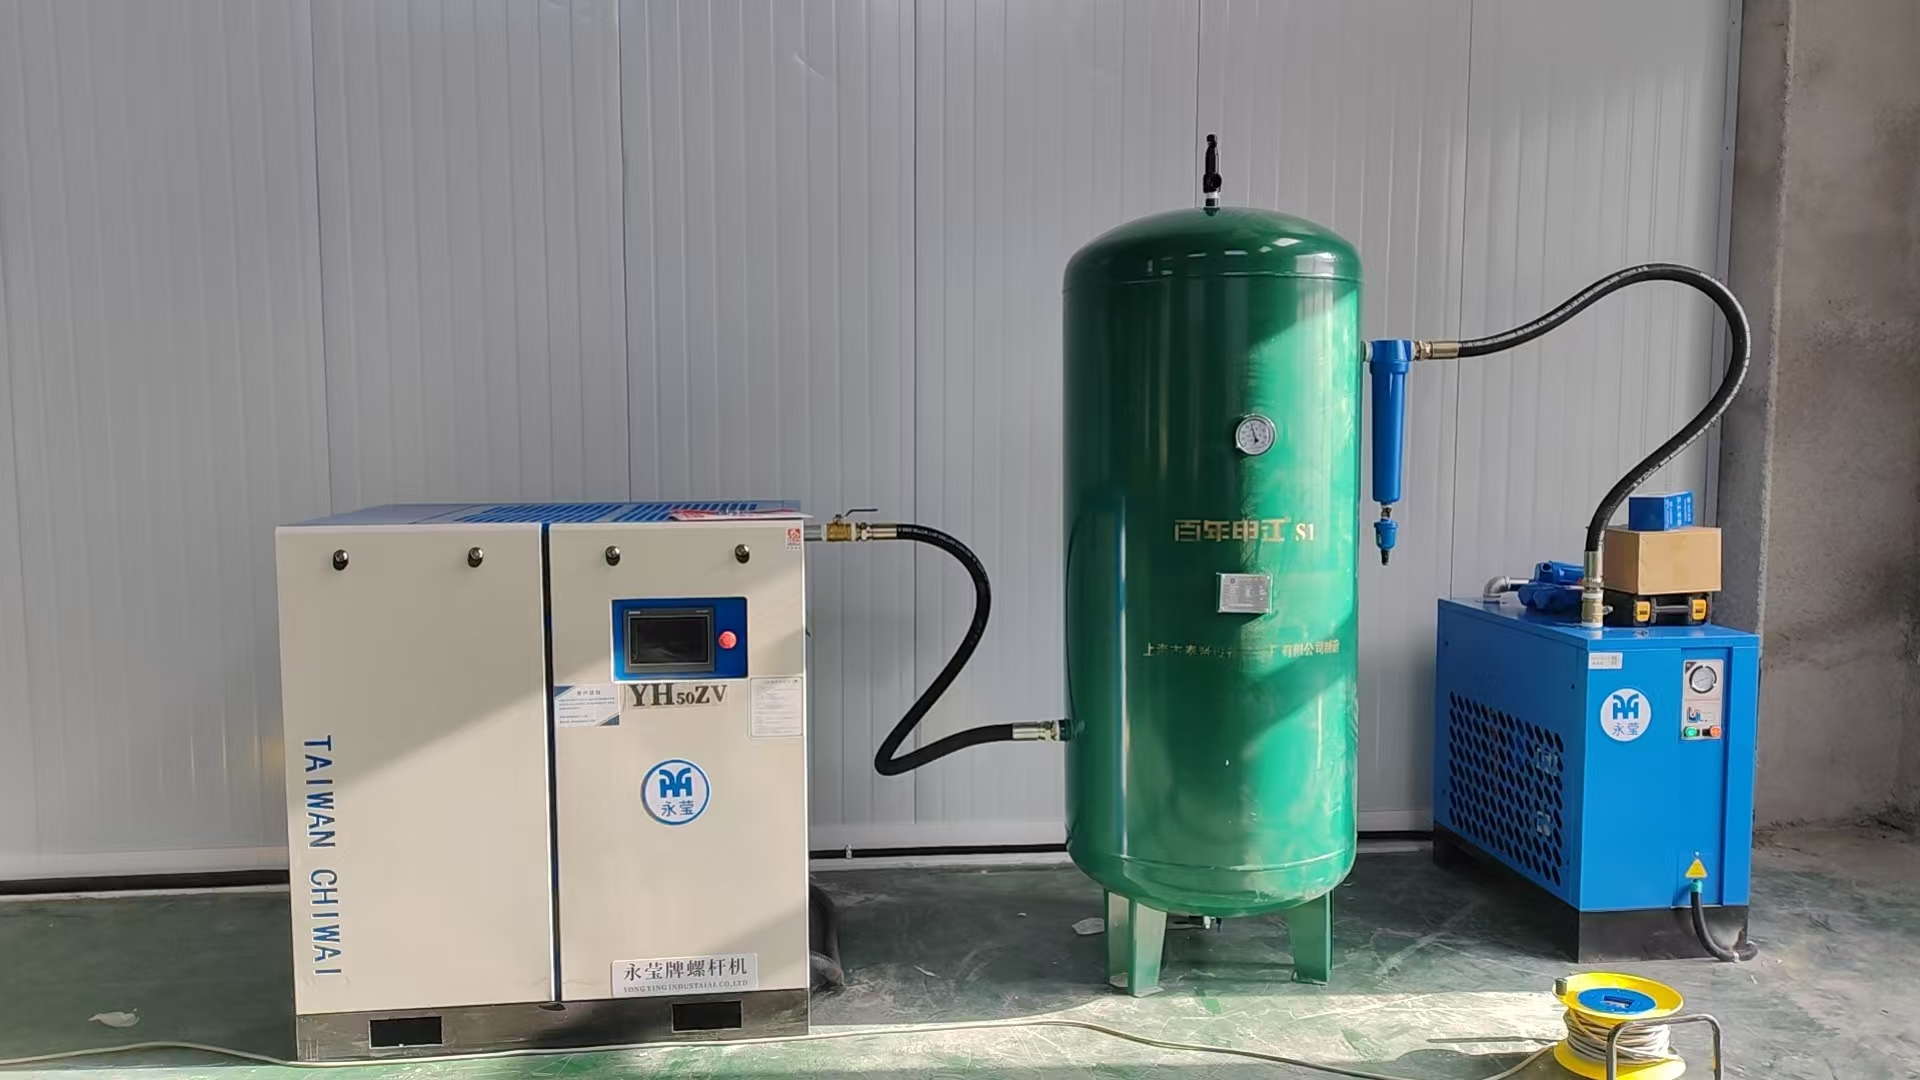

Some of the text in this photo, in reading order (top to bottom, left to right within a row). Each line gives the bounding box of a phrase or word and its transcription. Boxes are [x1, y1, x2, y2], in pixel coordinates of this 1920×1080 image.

[1174, 518, 1314, 542] 百年申江 S1
[661, 800, 694, 817] 永莹
[304, 735, 342, 975] TAIWAN CHIWAI
[623, 957, 747, 981] 永莹牌螺杆机
[623, 985, 646, 993] YONG
